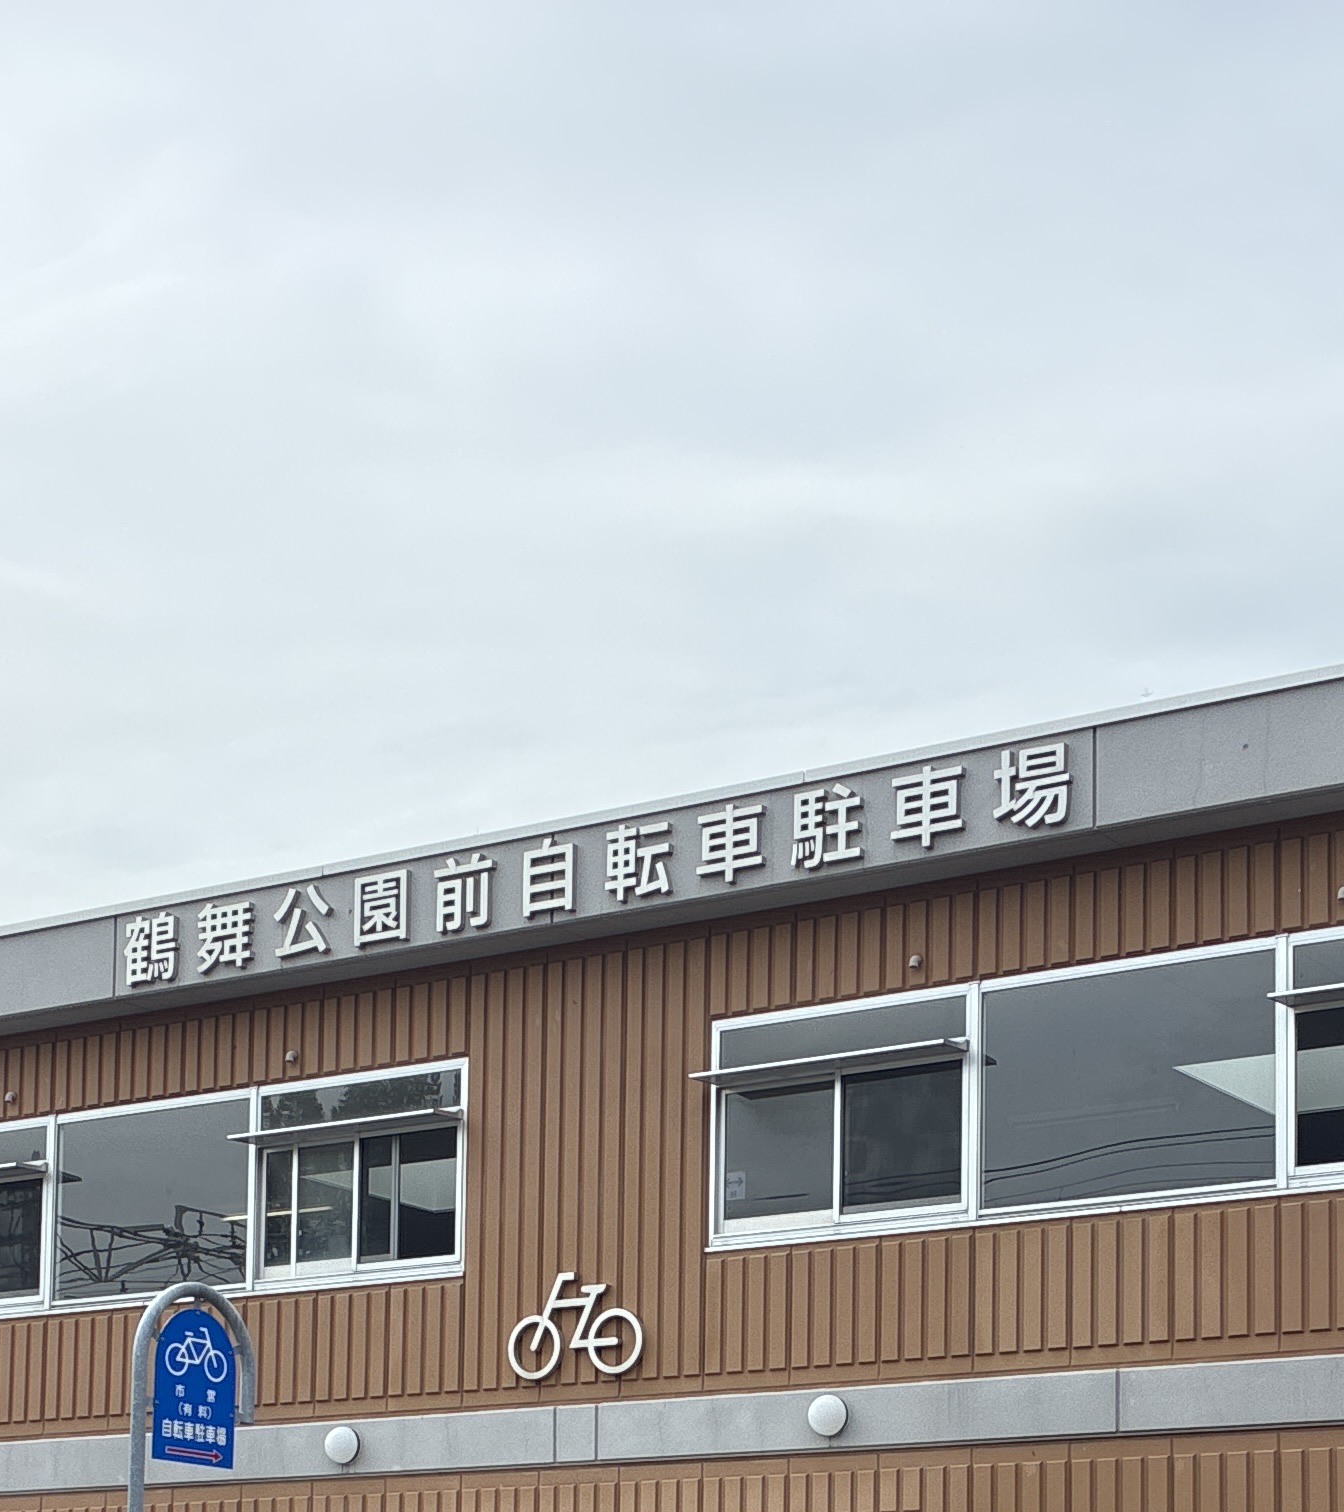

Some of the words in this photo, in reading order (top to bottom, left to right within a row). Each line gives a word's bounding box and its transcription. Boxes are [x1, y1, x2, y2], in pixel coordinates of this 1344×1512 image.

[124, 743, 1072, 987] 鶴舞公園前自転車駐車場
[162, 1418, 227, 1446] 自転車駐車場
